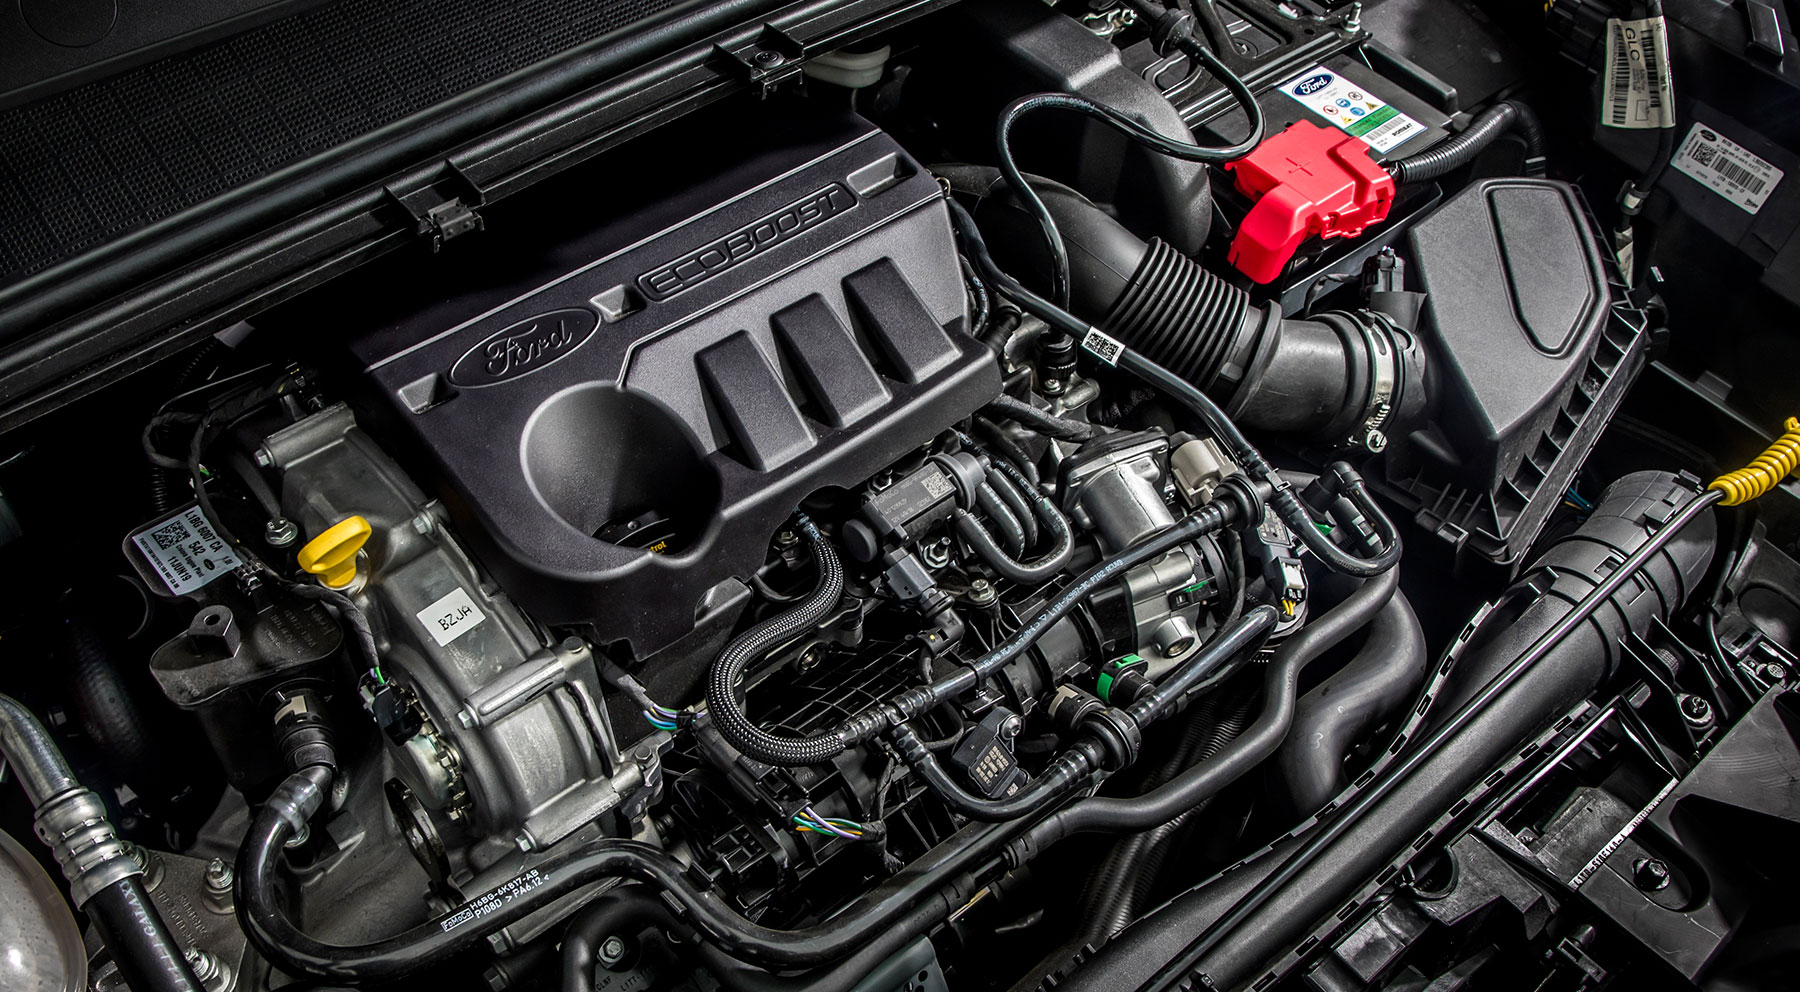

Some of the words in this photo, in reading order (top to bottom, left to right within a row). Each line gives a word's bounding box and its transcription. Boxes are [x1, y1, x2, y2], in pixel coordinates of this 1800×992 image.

[1625, 27, 1640, 61] GLC
[1299, 77, 1328, 95] Ford
[647, 190, 839, 296] ECOBOOST
[484, 320, 573, 377] Ford
[184, 510, 204, 528] L1BG
[197, 526, 217, 542] 6007
[209, 541, 224, 553] CA
[188, 540, 206, 556] 542
[167, 556, 192, 582] 11JUN19
[442, 909, 473, 930] FoMoCo
